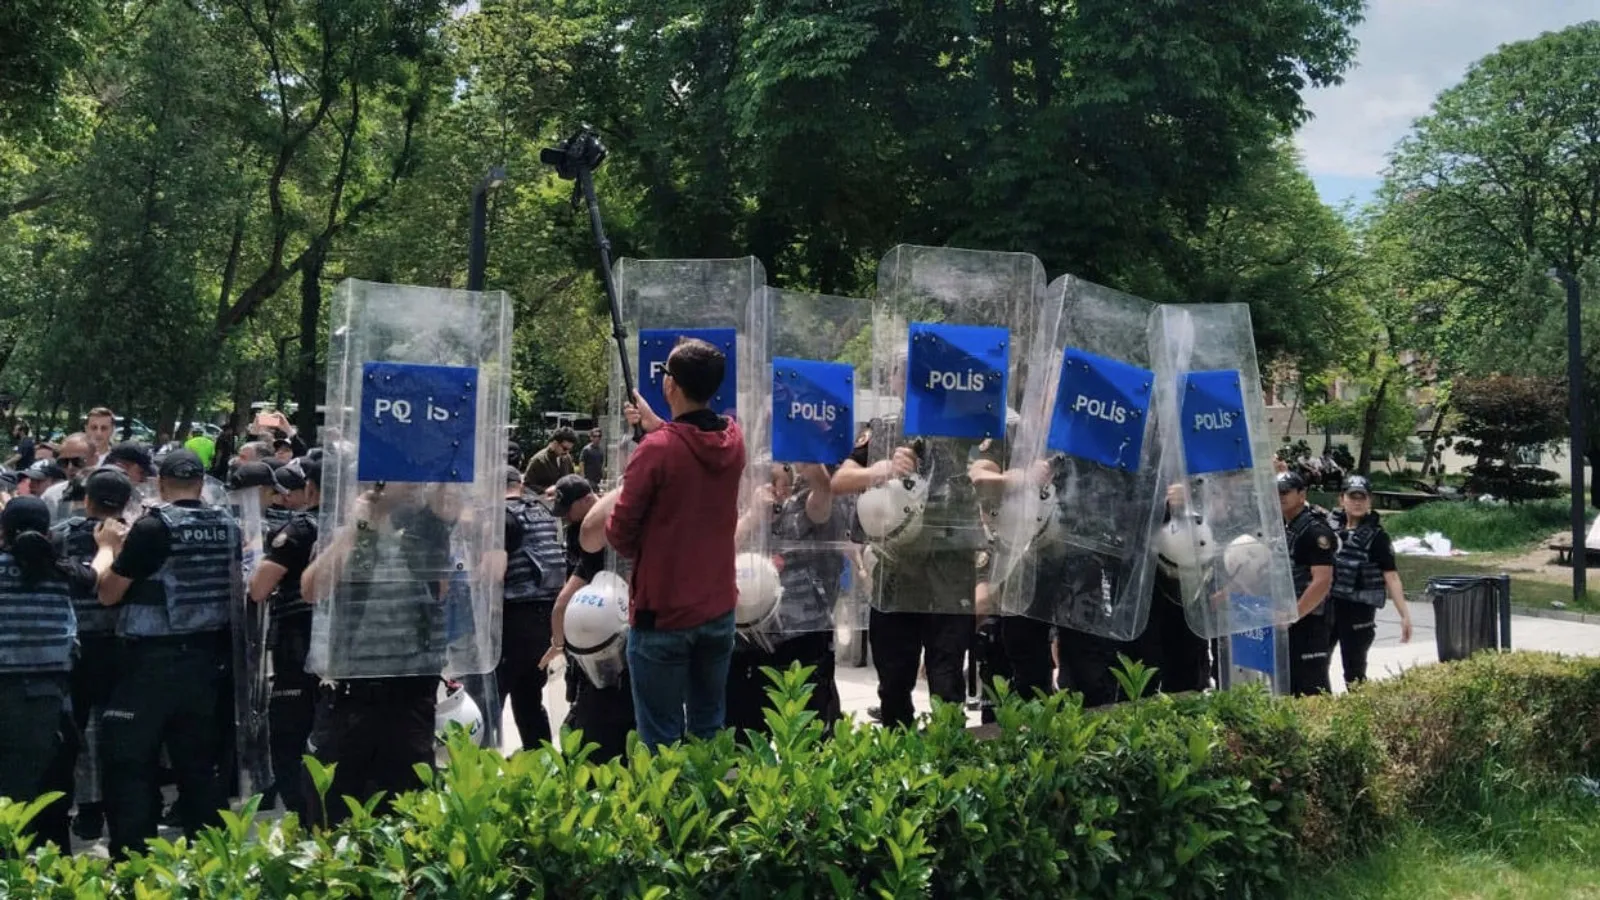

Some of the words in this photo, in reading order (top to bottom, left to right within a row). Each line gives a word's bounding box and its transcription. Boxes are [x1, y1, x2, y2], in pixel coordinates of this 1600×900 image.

[929, 368, 985, 392] POLİS
[791, 400, 837, 421] POLİS
[1075, 394, 1127, 424] POLİS
[183, 526, 227, 541] POLİS
